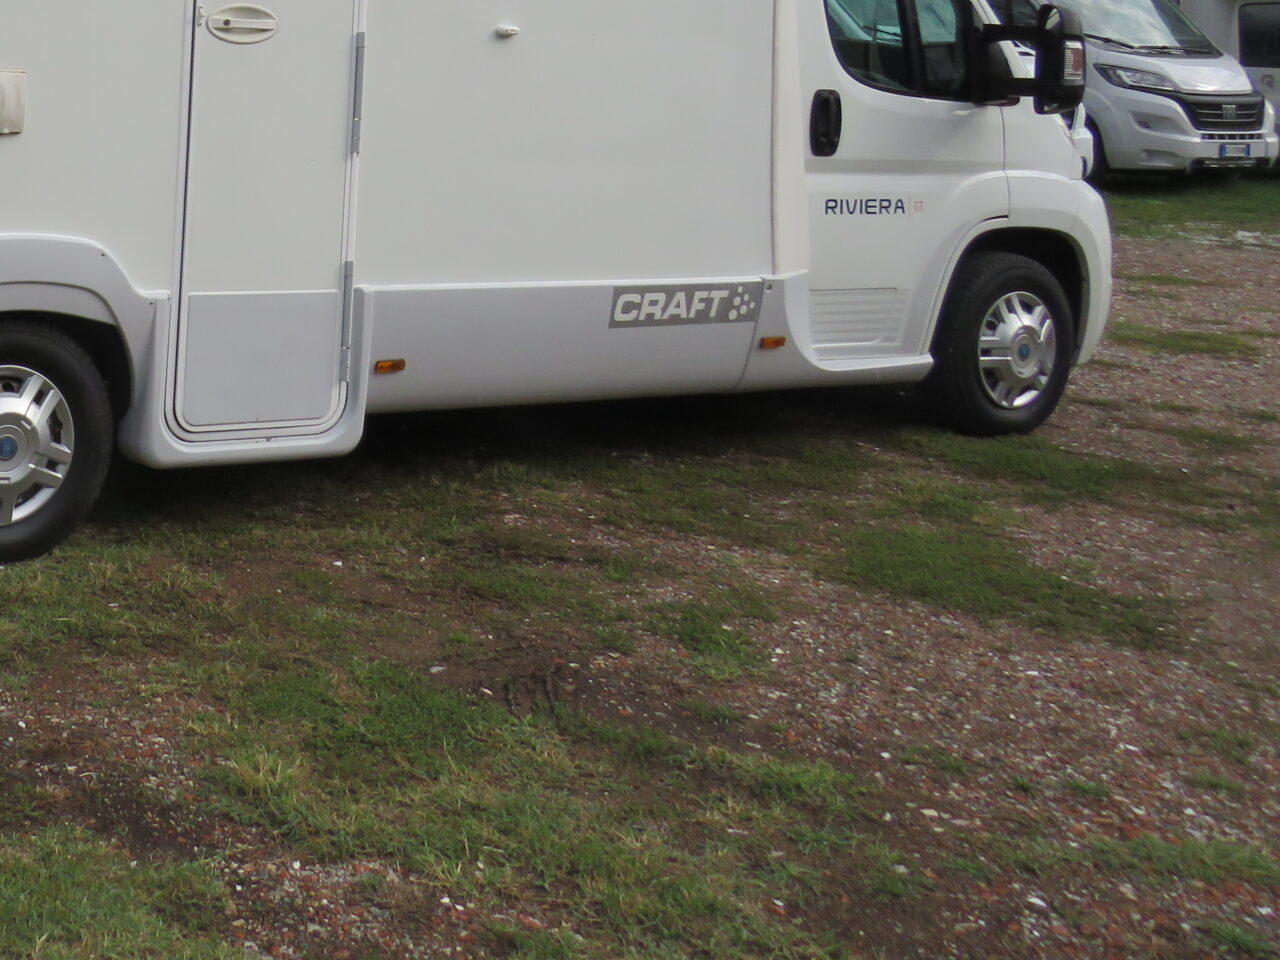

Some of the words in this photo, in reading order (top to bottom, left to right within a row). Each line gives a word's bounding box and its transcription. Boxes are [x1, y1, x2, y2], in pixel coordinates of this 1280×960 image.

[824, 198, 906, 215] RIVIERA
[913, 200, 925, 213] GT
[613, 289, 730, 322] CRAFT
